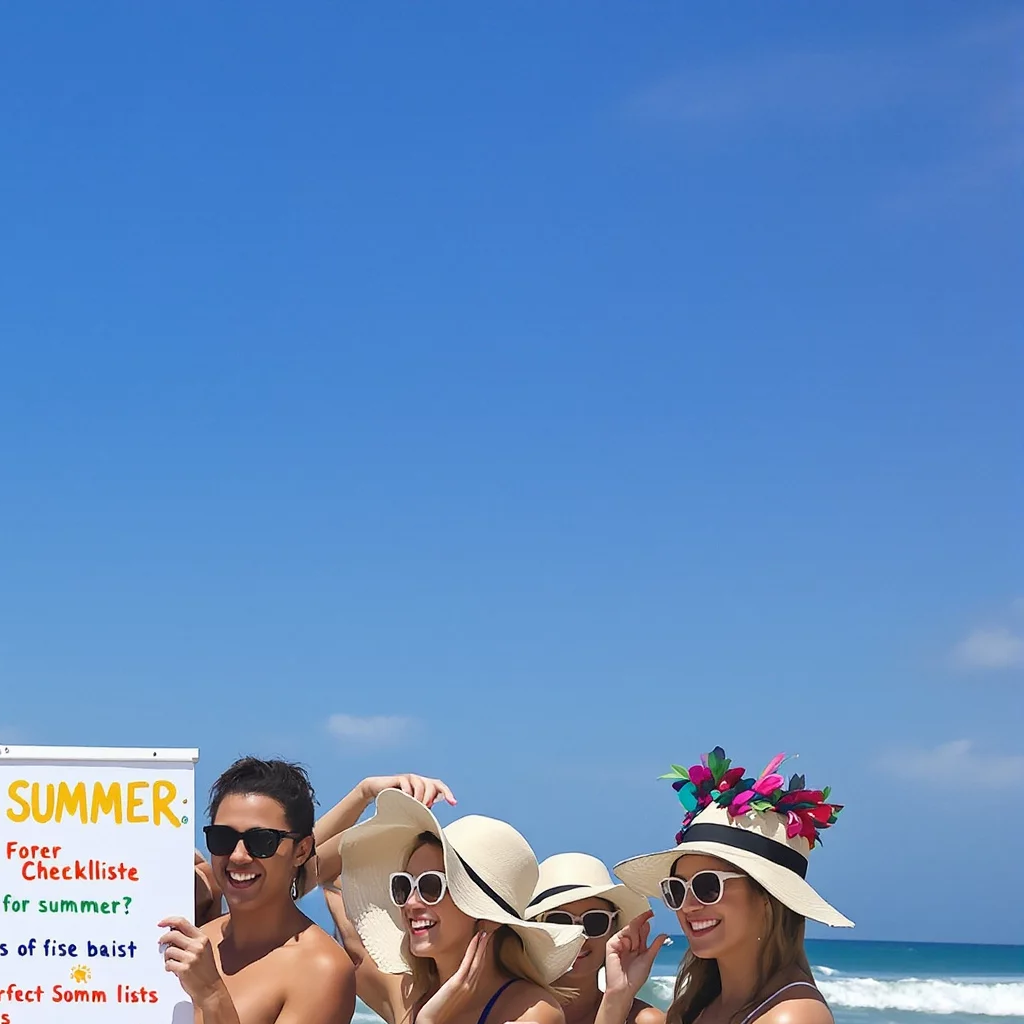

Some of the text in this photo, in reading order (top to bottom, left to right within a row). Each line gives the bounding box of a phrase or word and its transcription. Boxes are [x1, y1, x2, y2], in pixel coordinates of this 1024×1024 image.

[7, 841, 61, 861] Forer
[3, 895, 30, 912] for
[38, 896, 132, 915] summer?
[18, 938, 36, 956] of
[87, 940, 137, 958] baist
[52, 985, 106, 1002] Somm
[117, 985, 158, 1003] lists
